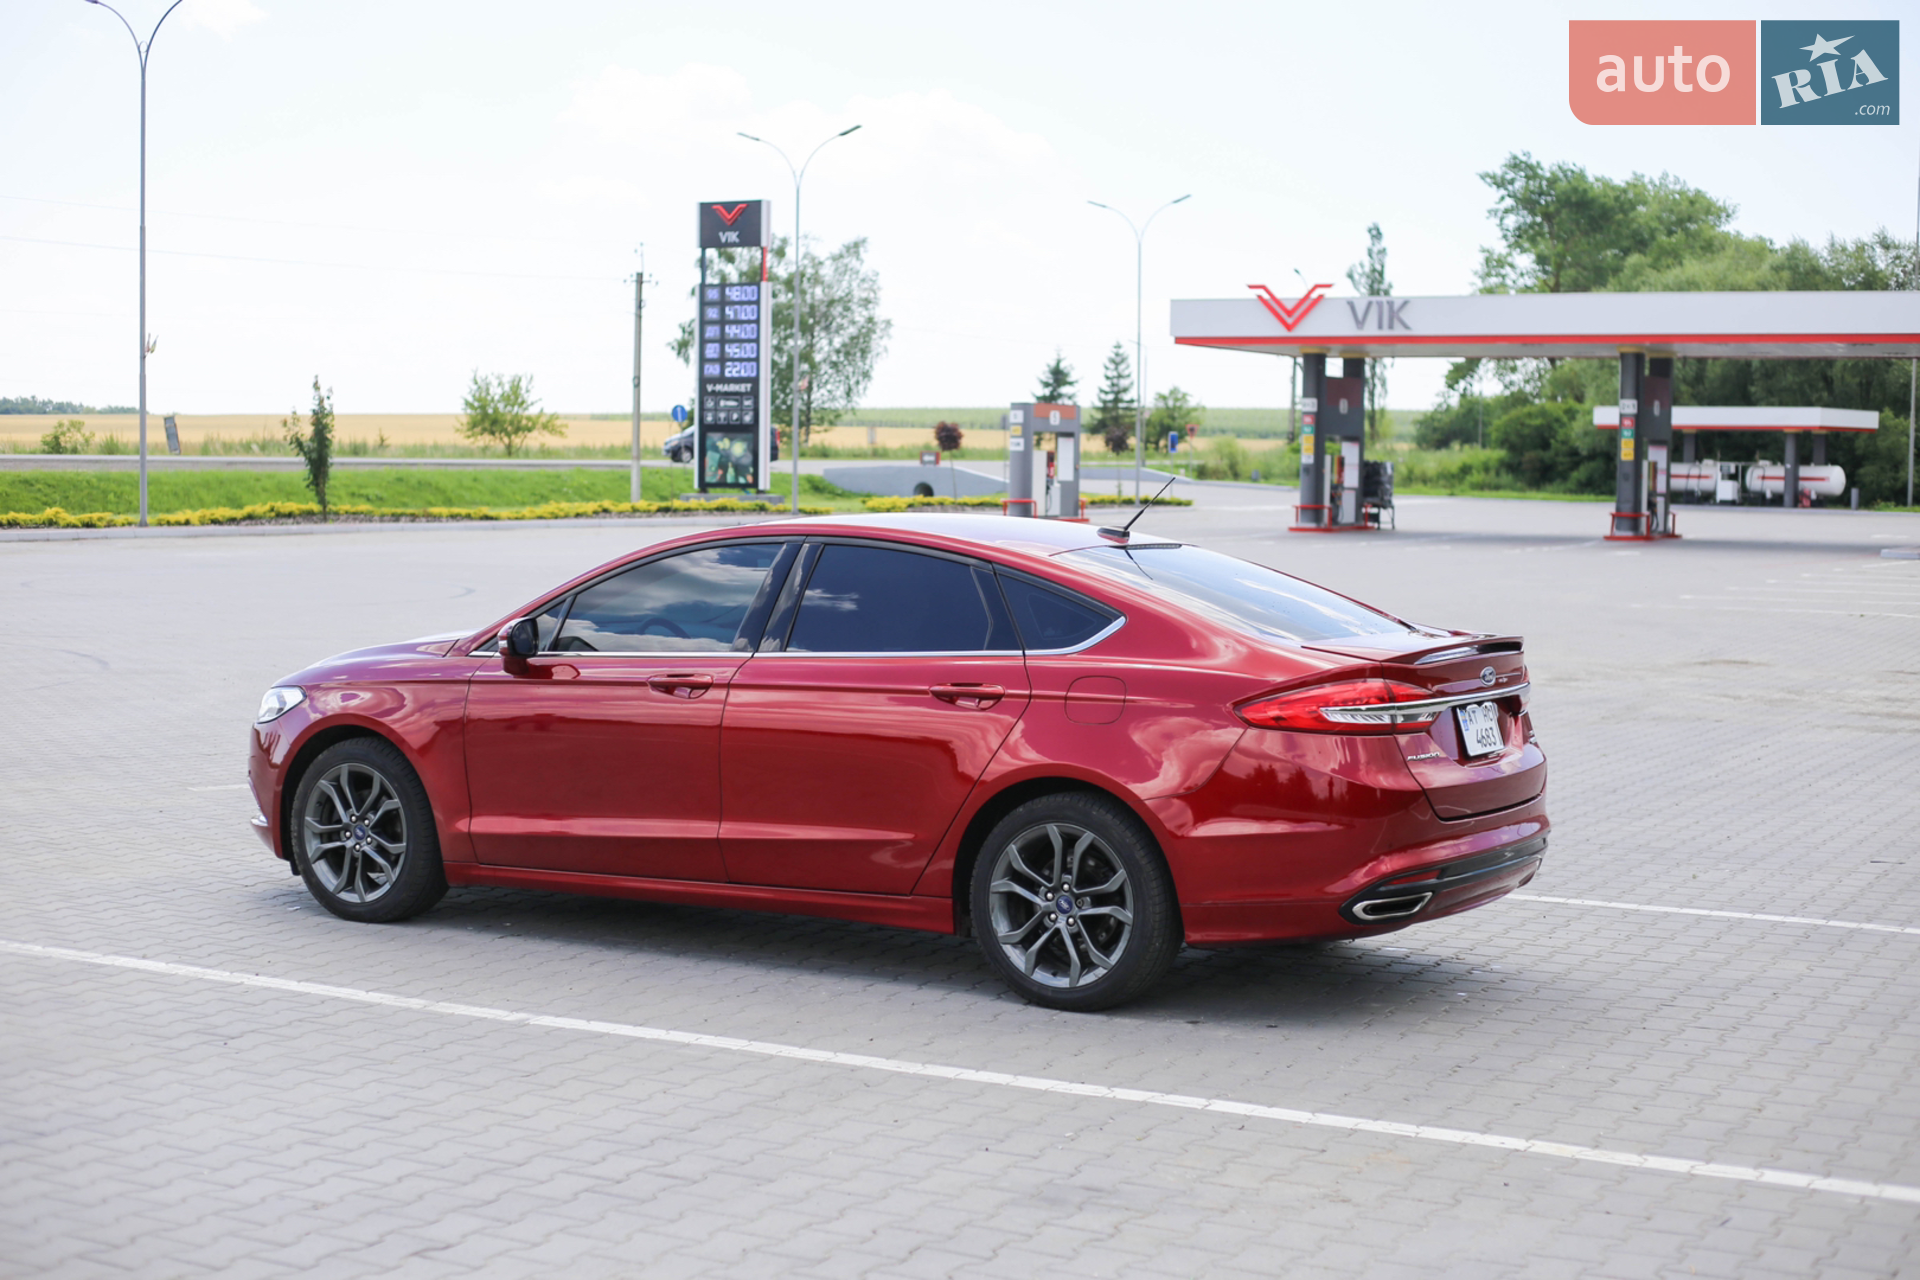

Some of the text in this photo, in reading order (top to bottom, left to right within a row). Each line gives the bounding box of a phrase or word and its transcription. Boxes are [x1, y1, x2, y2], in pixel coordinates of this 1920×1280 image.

[718, 231, 740, 243] VIK
[1346, 300, 1412, 330] VIK
[706, 383, 752, 393] V-MARKET
[1476, 726, 1497, 748] 4683
